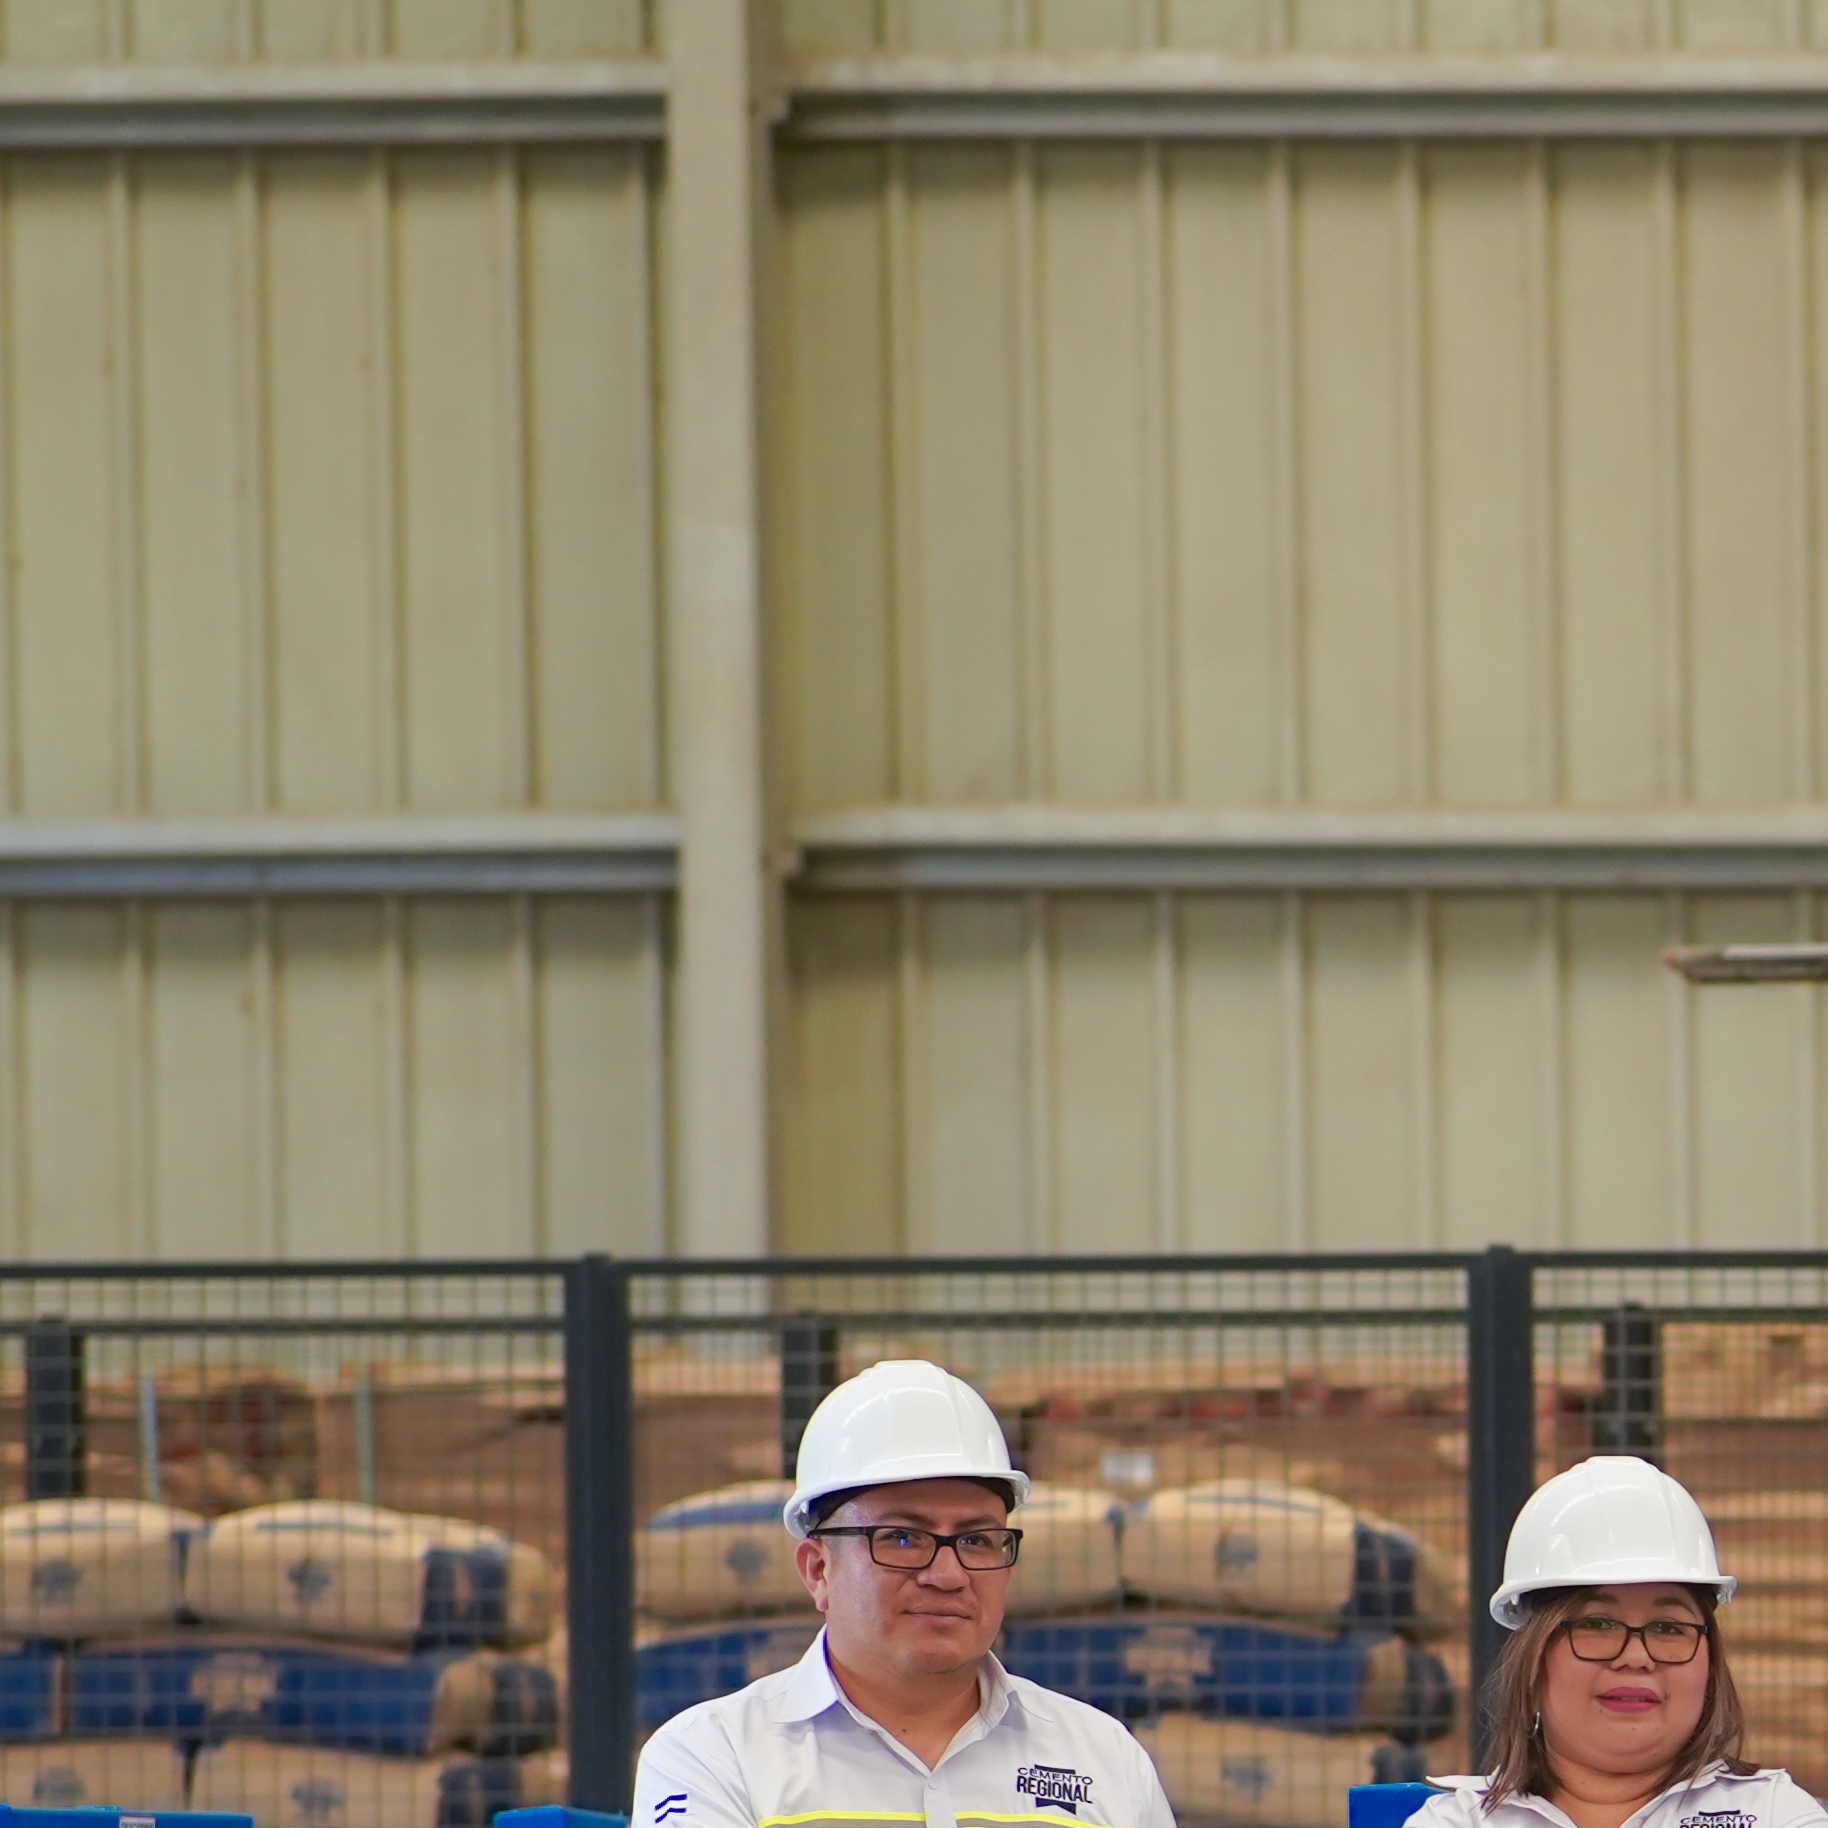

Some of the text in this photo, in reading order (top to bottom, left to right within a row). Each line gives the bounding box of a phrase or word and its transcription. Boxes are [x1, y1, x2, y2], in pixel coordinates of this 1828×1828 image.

[1017, 1767, 1093, 1785] CEMENTO
[1016, 1775, 1094, 1805] REGIONAL
[1680, 1814, 1758, 1825] CEMENTO
